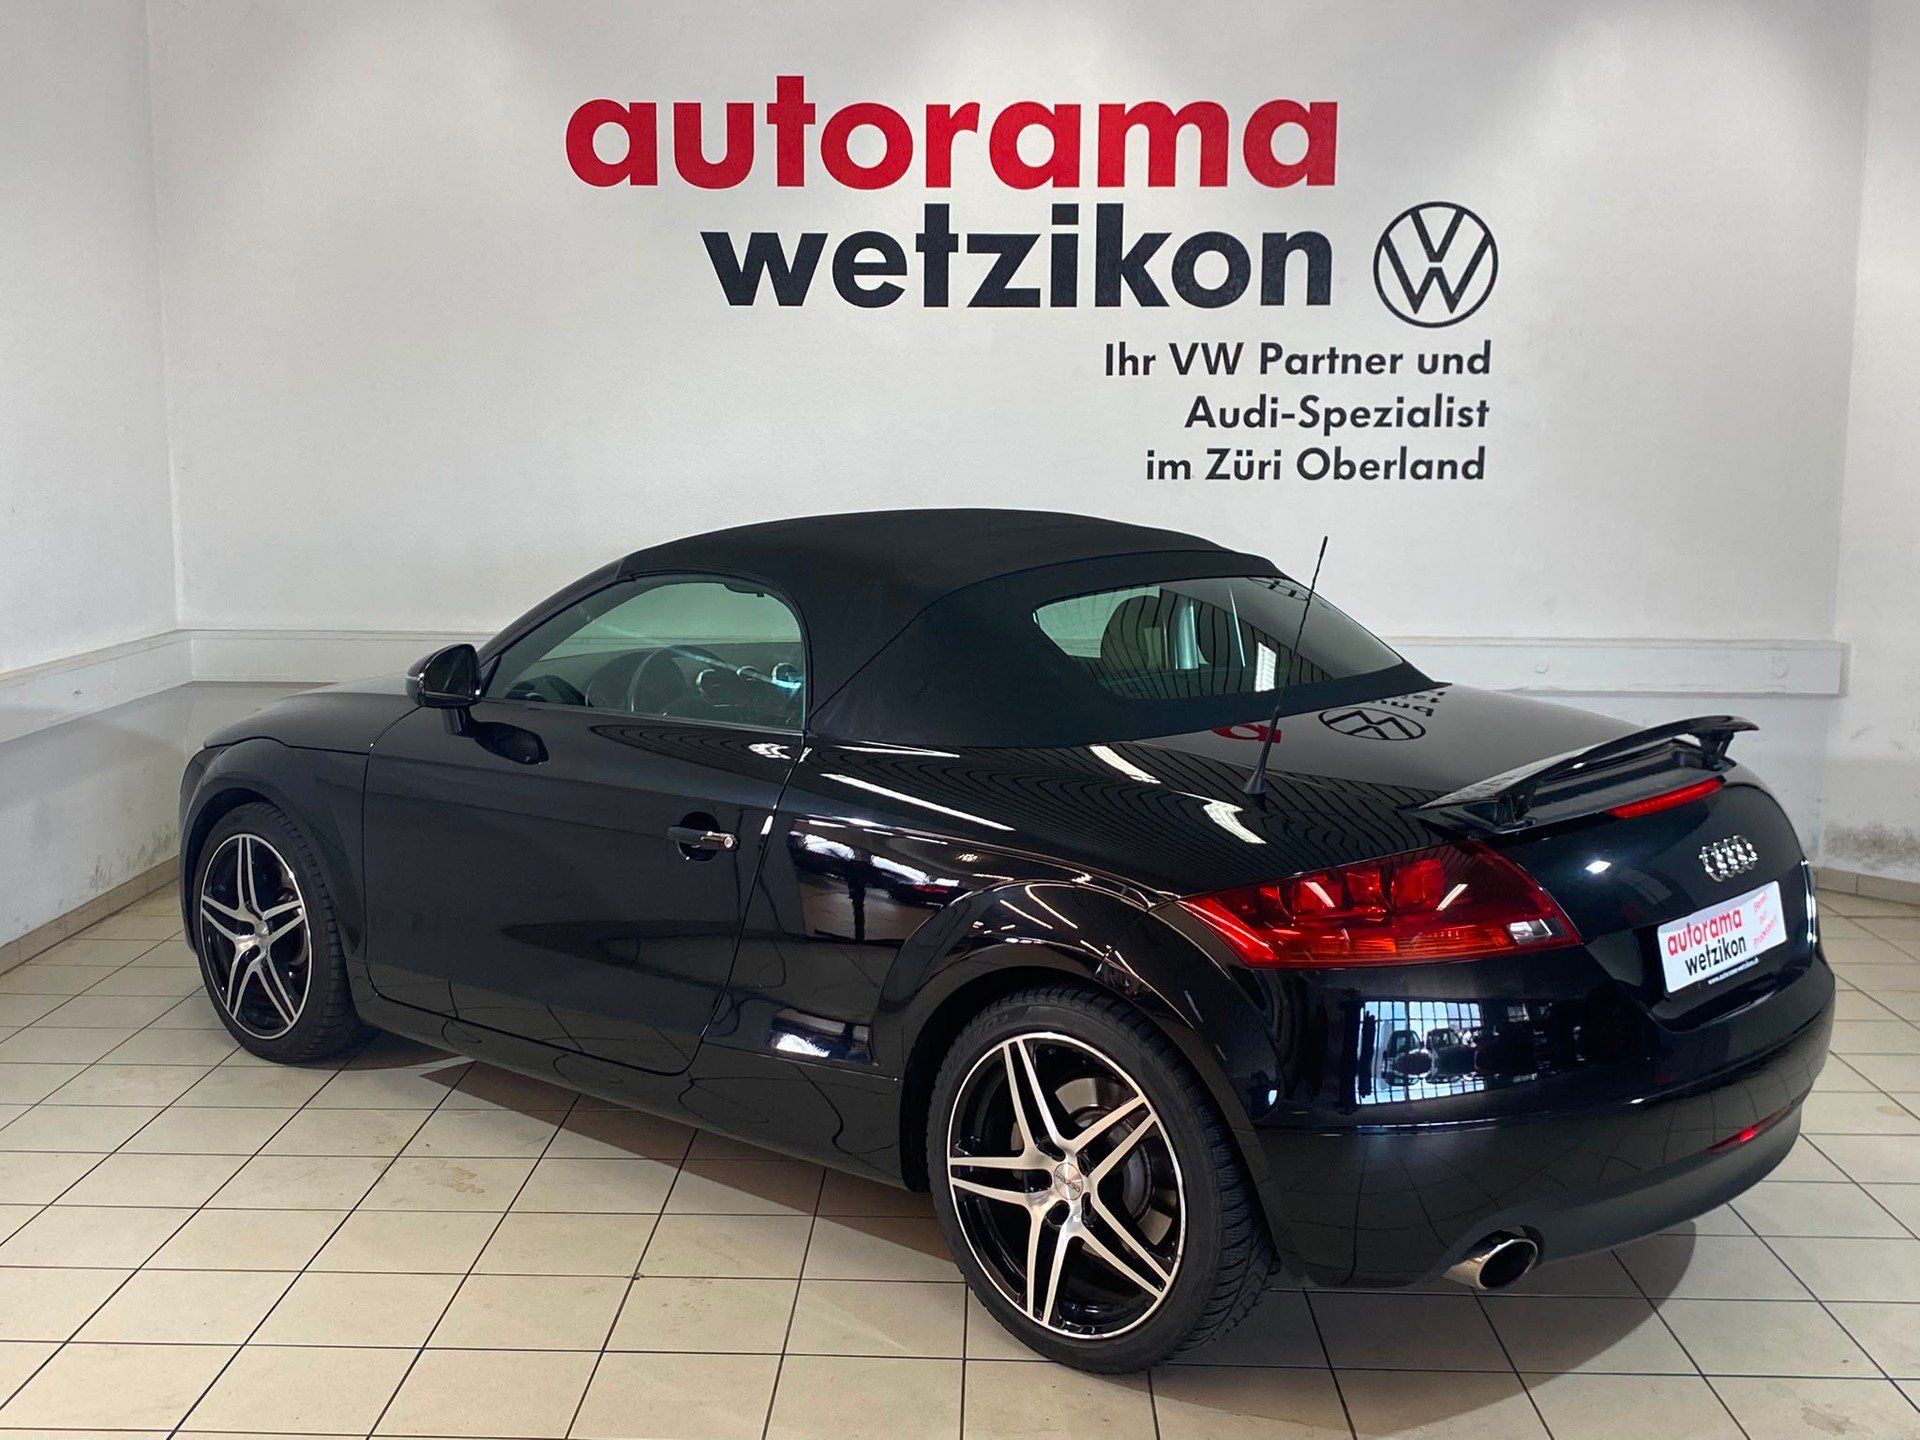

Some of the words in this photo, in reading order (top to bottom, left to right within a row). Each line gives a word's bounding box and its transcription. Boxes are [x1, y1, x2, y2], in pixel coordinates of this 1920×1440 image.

[566, 75, 1338, 191] autorama
[700, 202, 1333, 308] wetzikon
[1105, 341, 1156, 376] Ihr
[1169, 342, 1244, 376] VW
[1260, 342, 1404, 375] Partner
[1417, 340, 1492, 375] und
[1184, 393, 1490, 437] Audi-Spezialist
[1146, 449, 1191, 480] im
[1205, 448, 1282, 480] Züri
[1296, 446, 1486, 481] Oberland
[1667, 909, 1743, 957] autorama
[1684, 936, 1747, 976] wetzikon
